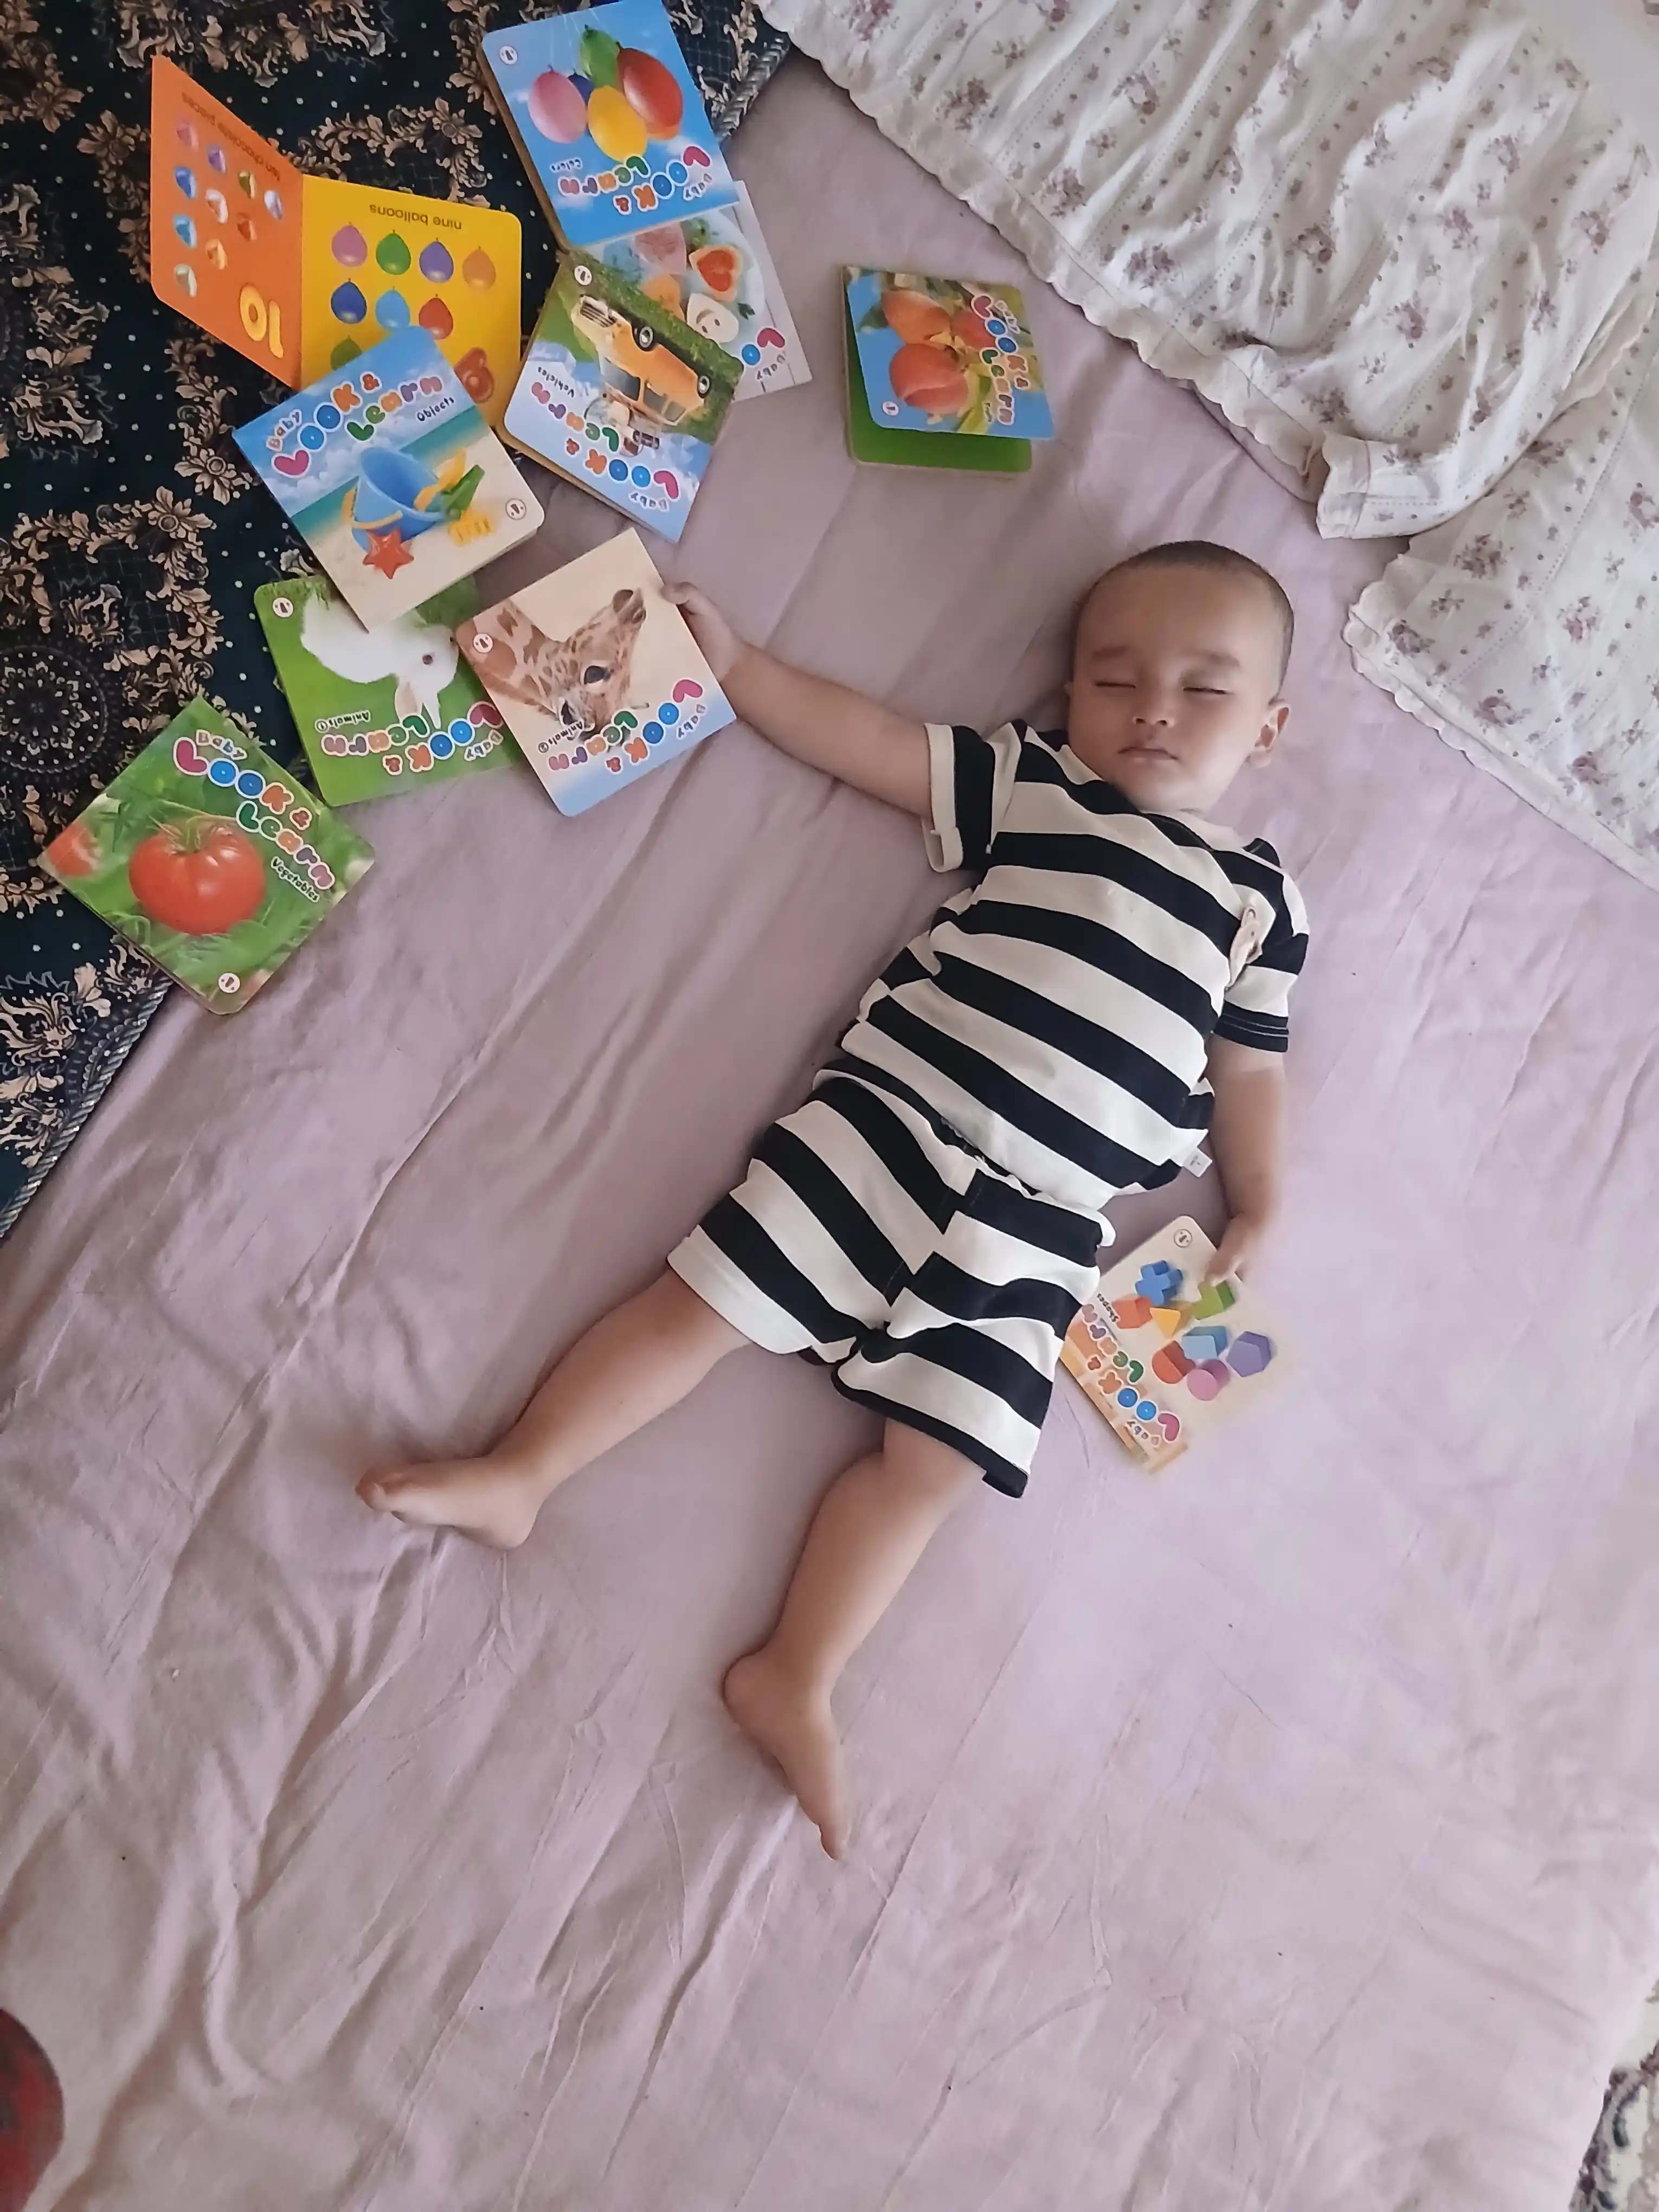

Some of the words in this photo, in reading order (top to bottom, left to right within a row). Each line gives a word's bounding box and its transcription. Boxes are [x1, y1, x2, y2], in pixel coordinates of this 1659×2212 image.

[558, 155, 650, 196] Learn
[683, 173, 713, 200] Baby
[369, 204, 428, 226] balloons
[433, 217, 462, 230] nine
[240, 284, 284, 358] 10
[538, 366, 575, 398] Vehicles
[345, 376, 443, 442] Learn
[416, 396, 455, 422] Objects
[531, 381, 620, 453] Learn
[267, 409, 301, 452] Baby
[629, 491, 670, 511] Baby
[322, 715, 429, 756] Learn
[676, 703, 706, 739] Baby
[195, 729, 247, 760] Baby
[464, 730, 504, 762] Baby
[548, 710, 639, 771] Learn
[236, 800, 335, 890] Learn
[271, 857, 319, 903] Vegetables
[1096, 1293, 1119, 1323] Shapes
[1082, 1303, 1144, 1384] Learn
